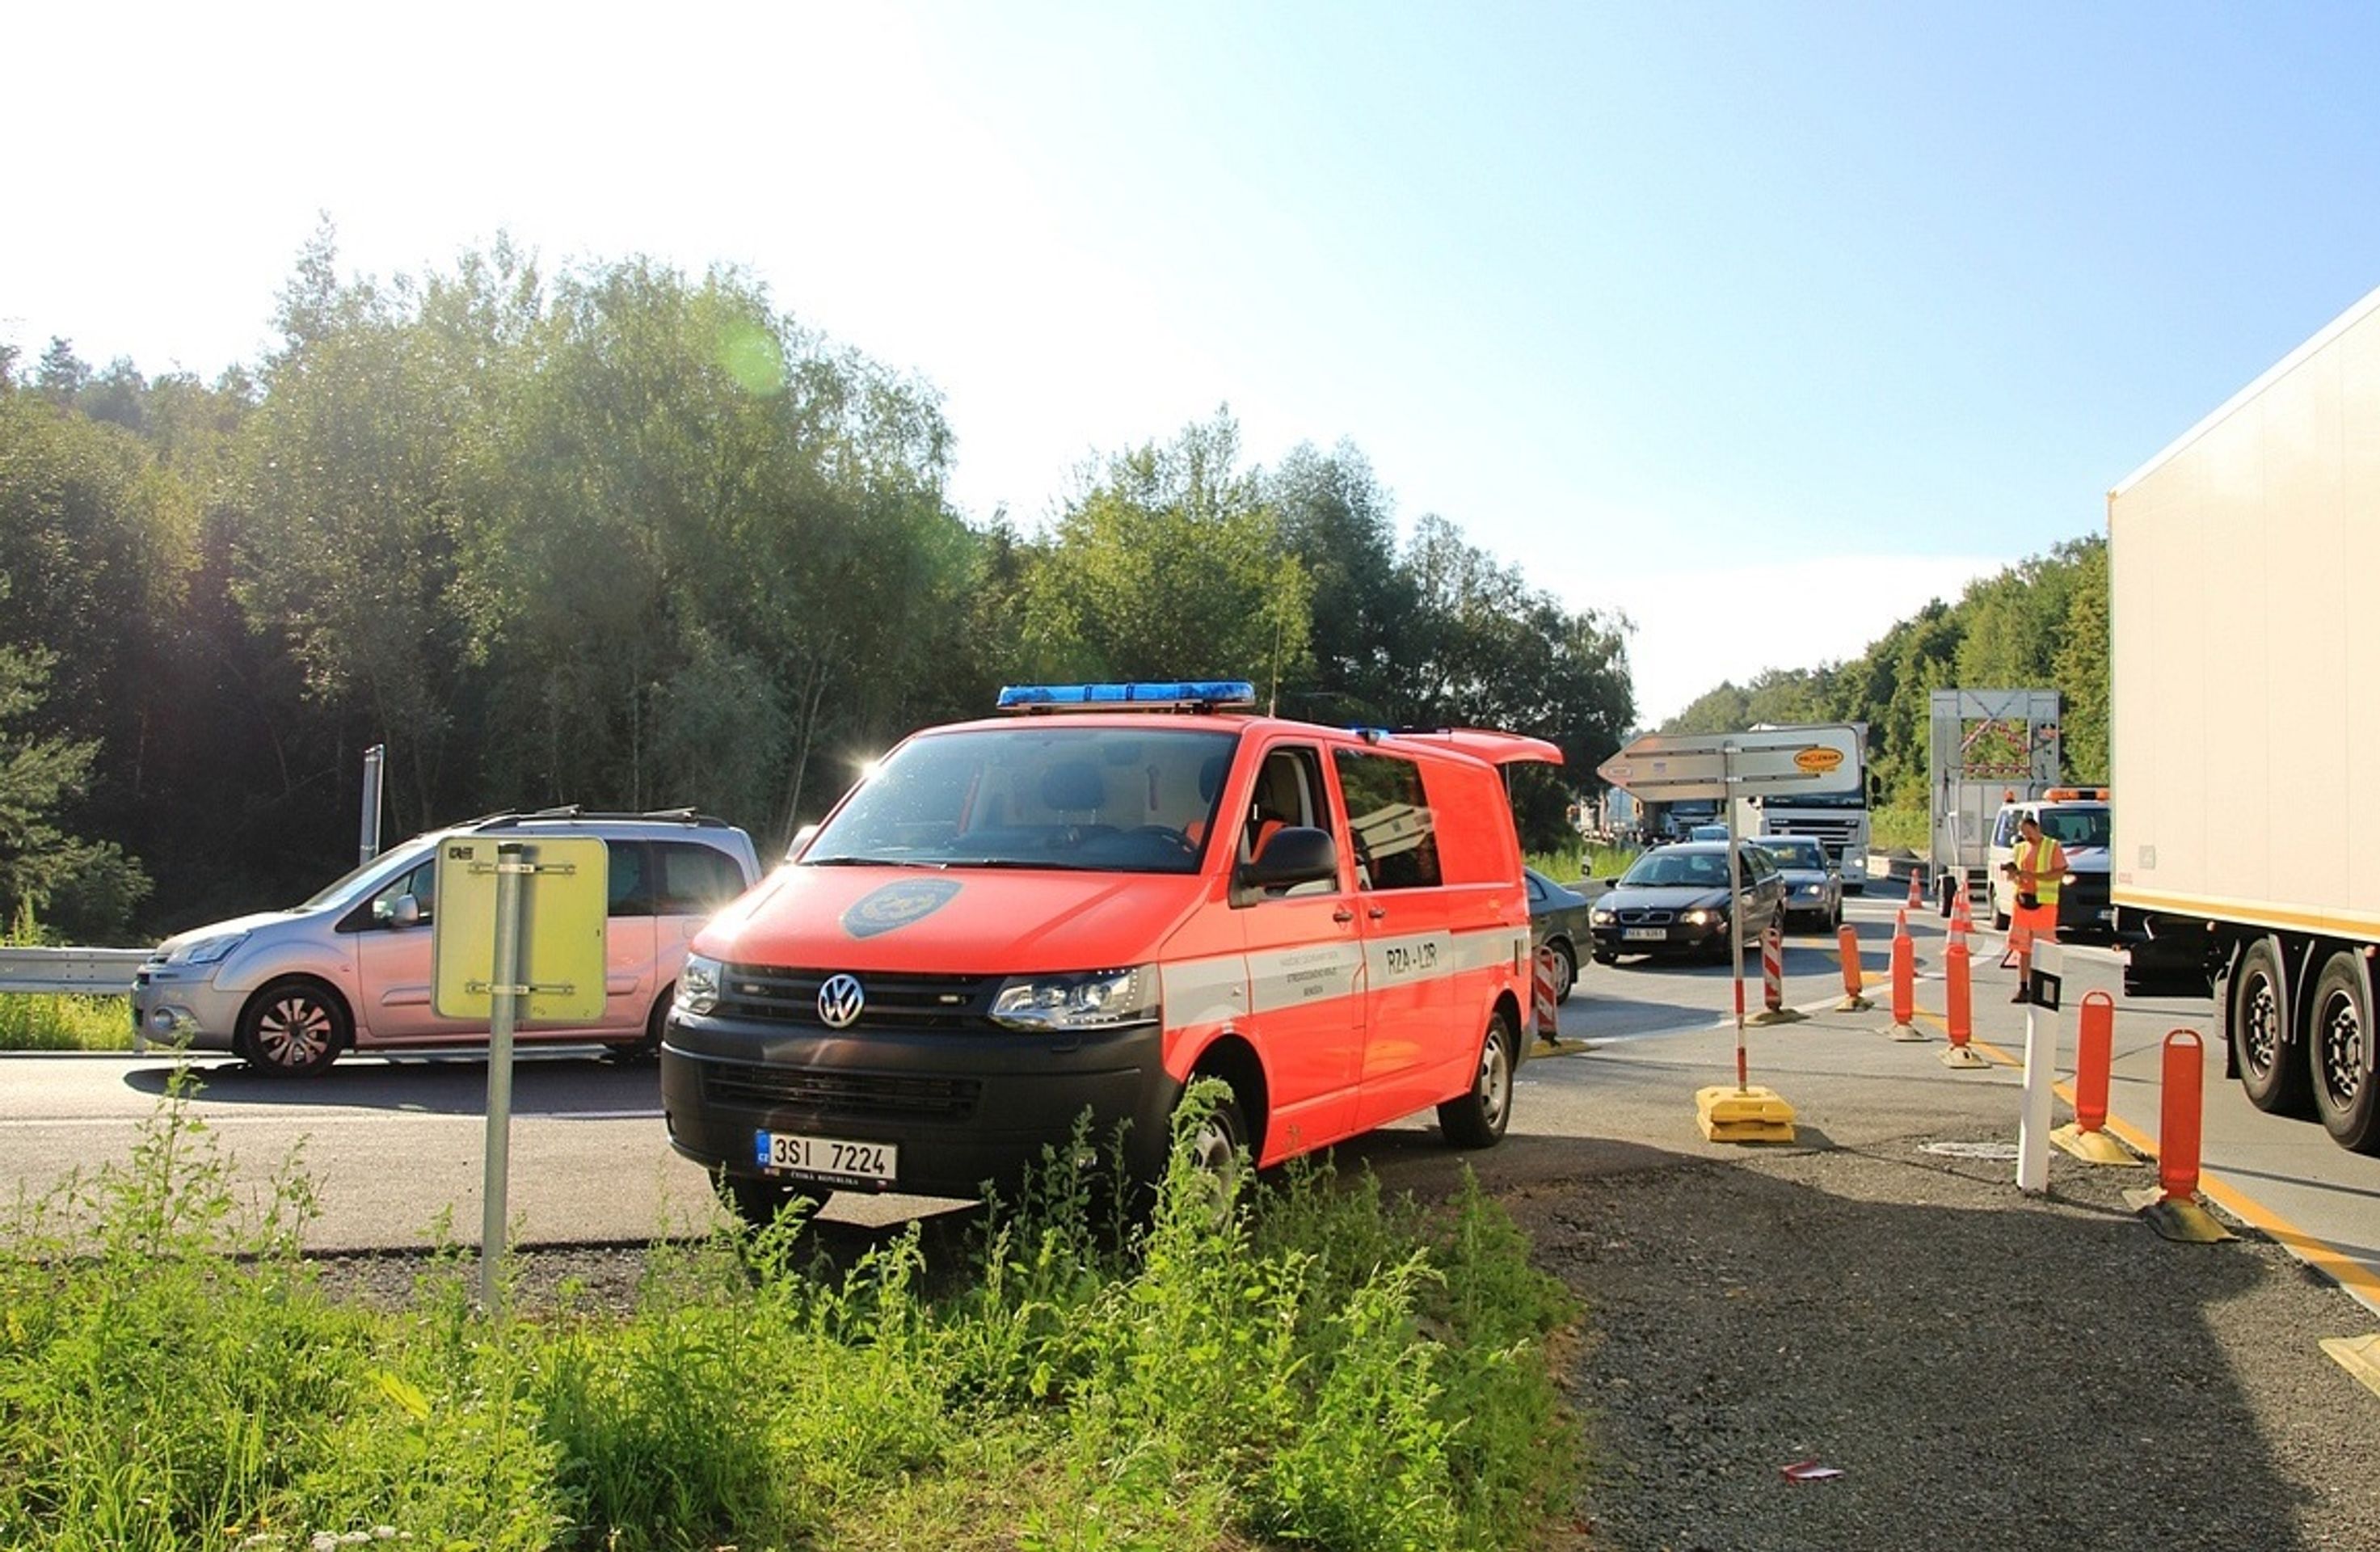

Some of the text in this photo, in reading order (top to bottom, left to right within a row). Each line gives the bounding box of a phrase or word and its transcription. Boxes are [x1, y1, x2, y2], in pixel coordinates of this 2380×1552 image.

[1387, 947, 1412, 975] RZA
[774, 1138, 886, 1175] 3SI 7224
